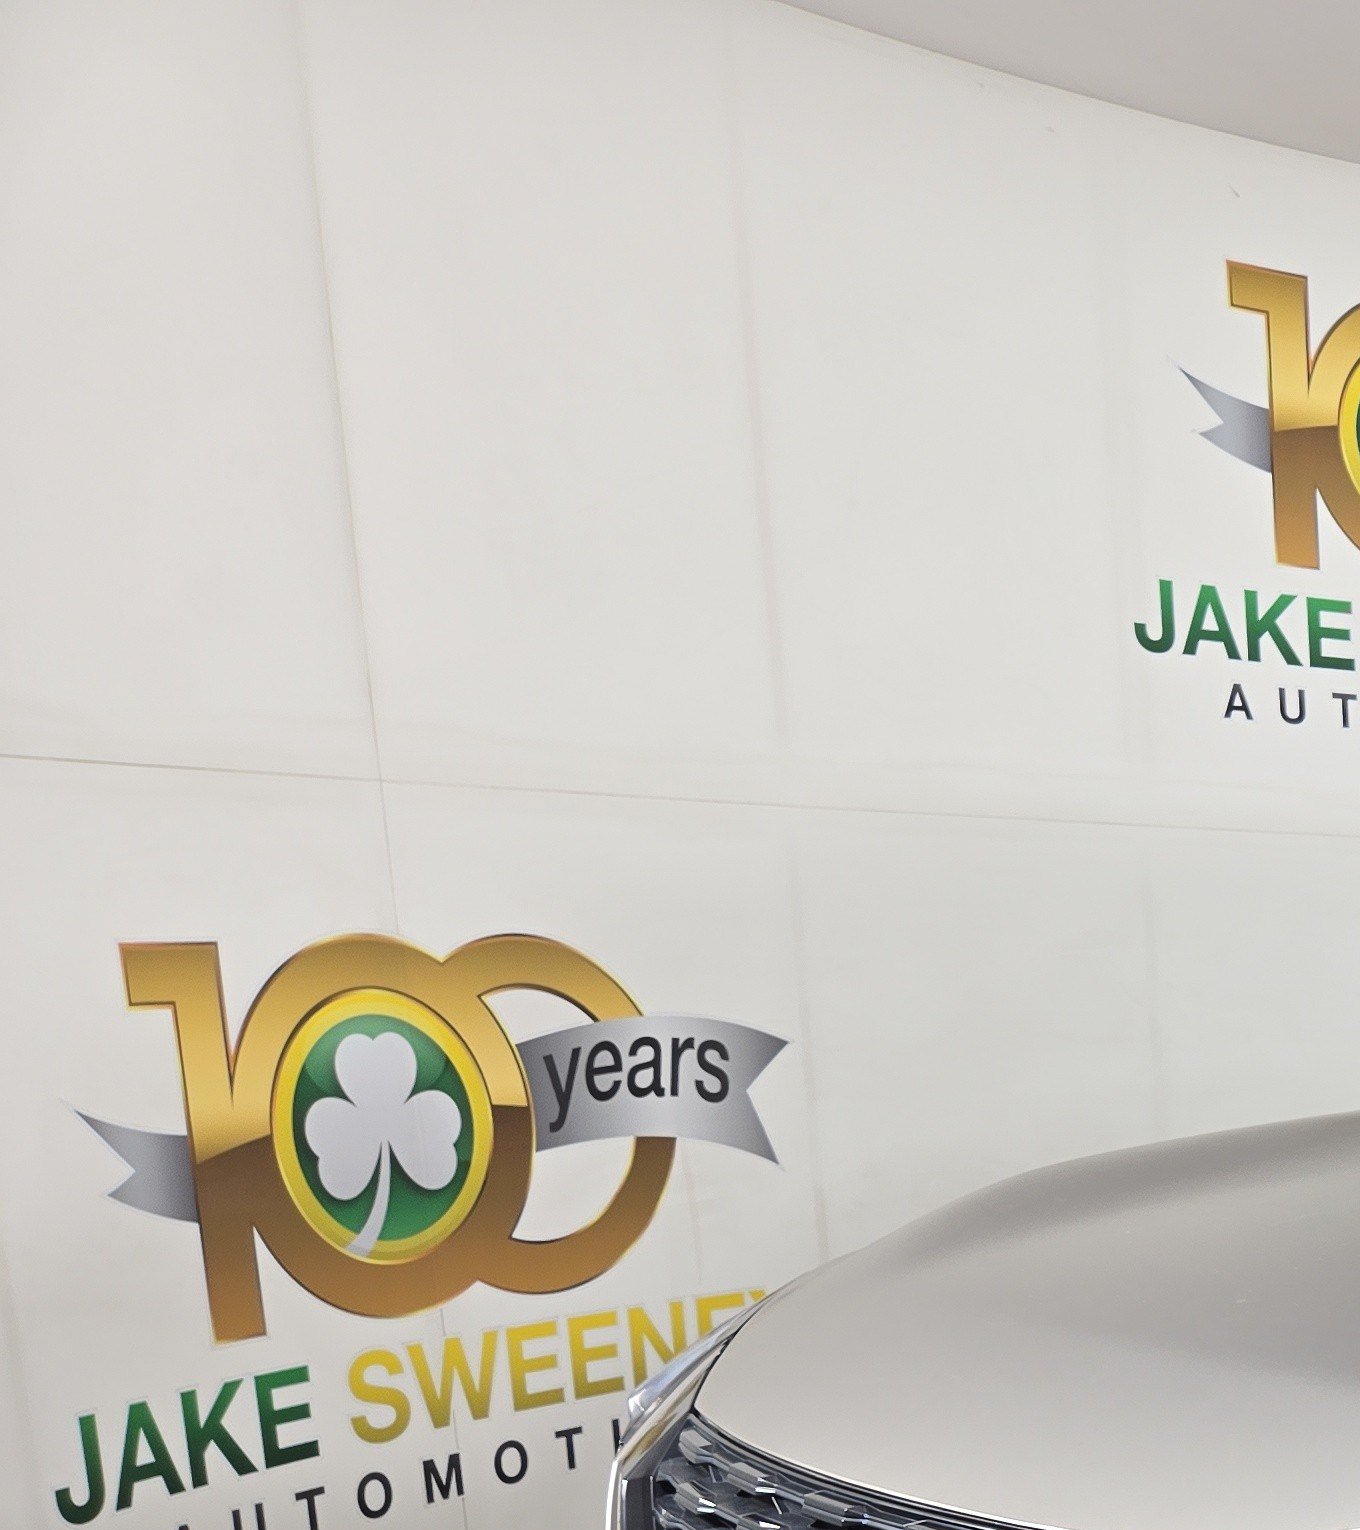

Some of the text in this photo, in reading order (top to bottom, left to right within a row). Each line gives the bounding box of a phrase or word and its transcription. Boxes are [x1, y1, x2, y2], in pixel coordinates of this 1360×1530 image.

[1134, 579, 1355, 671] JAKE
[118, 932, 730, 1345] 100 years
[55, 1288, 767, 1526] JAKE SWEEN
